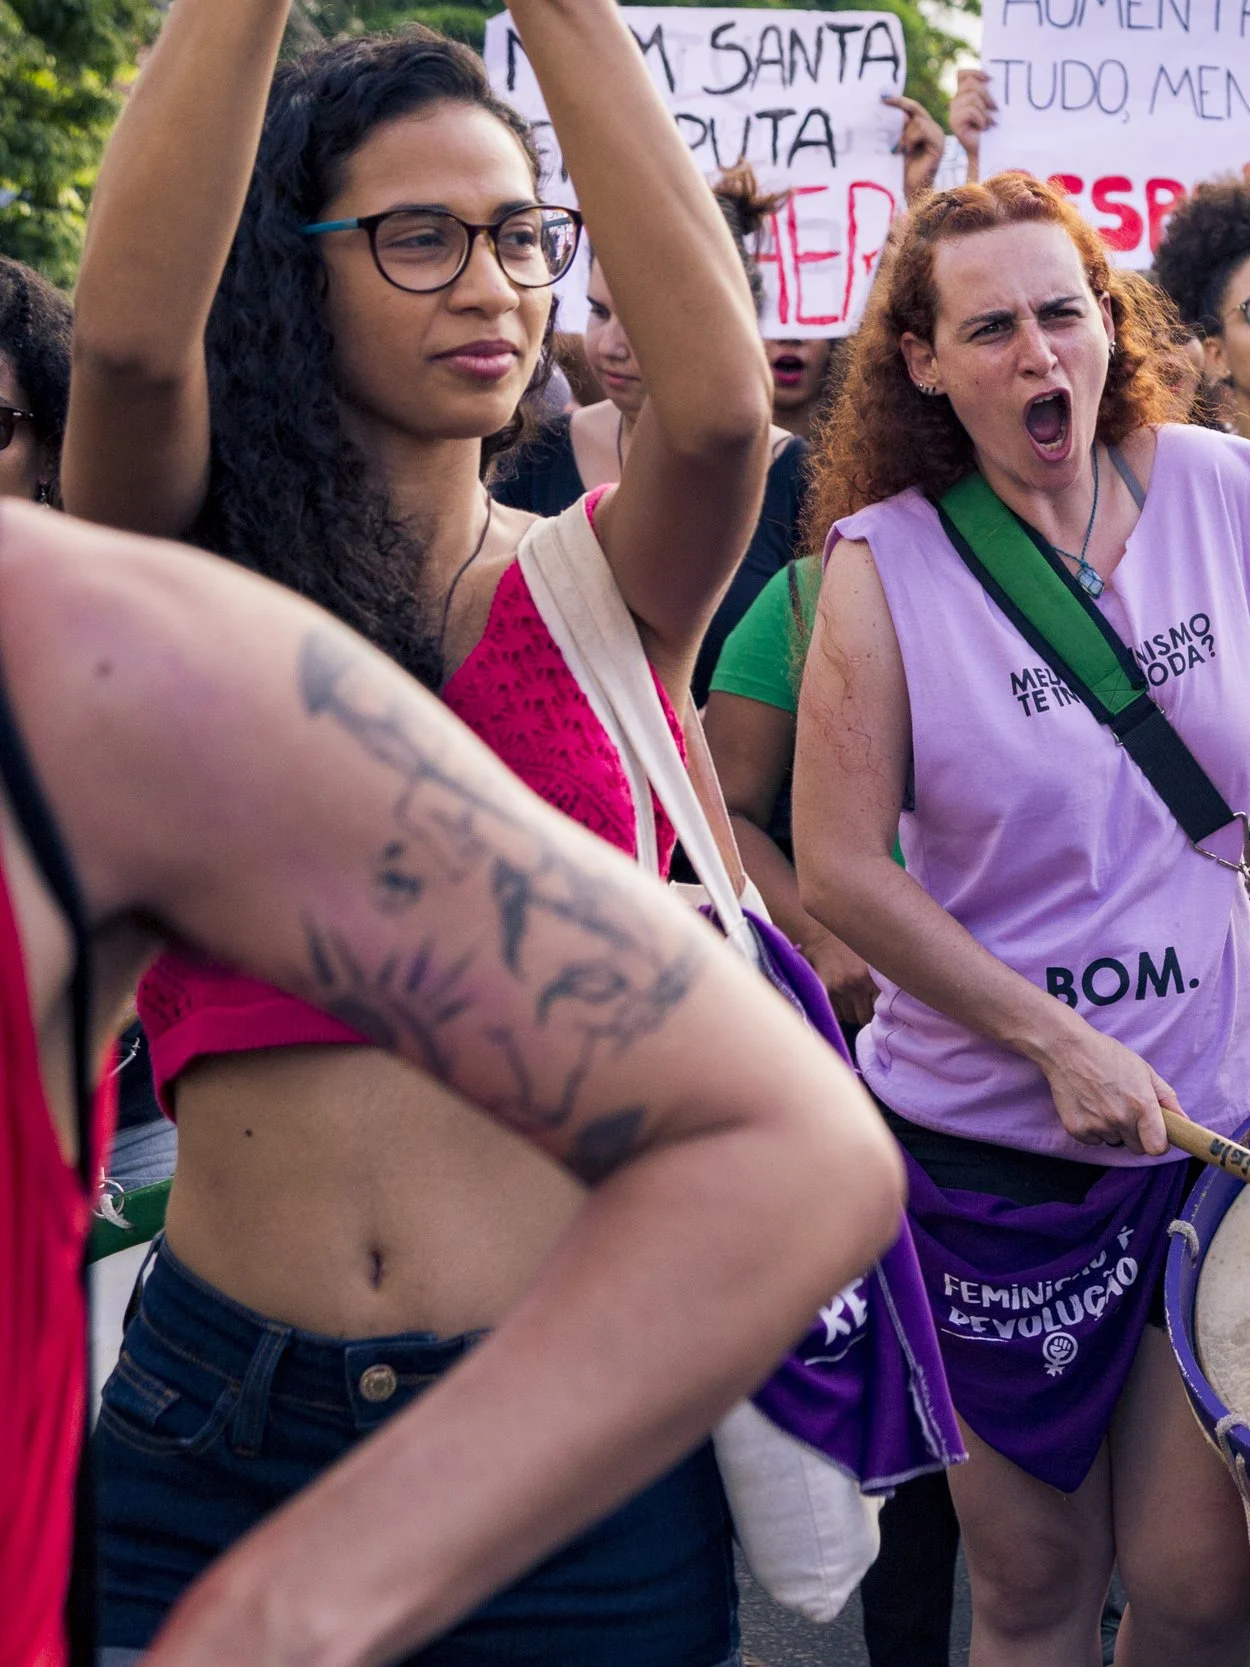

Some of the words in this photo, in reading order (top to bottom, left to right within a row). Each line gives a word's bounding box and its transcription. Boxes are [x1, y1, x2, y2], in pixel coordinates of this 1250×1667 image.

[702, 20, 899, 96] SANTA
[1017, 689, 1051, 718] TE
[1045, 945, 1200, 1011] BOM.
